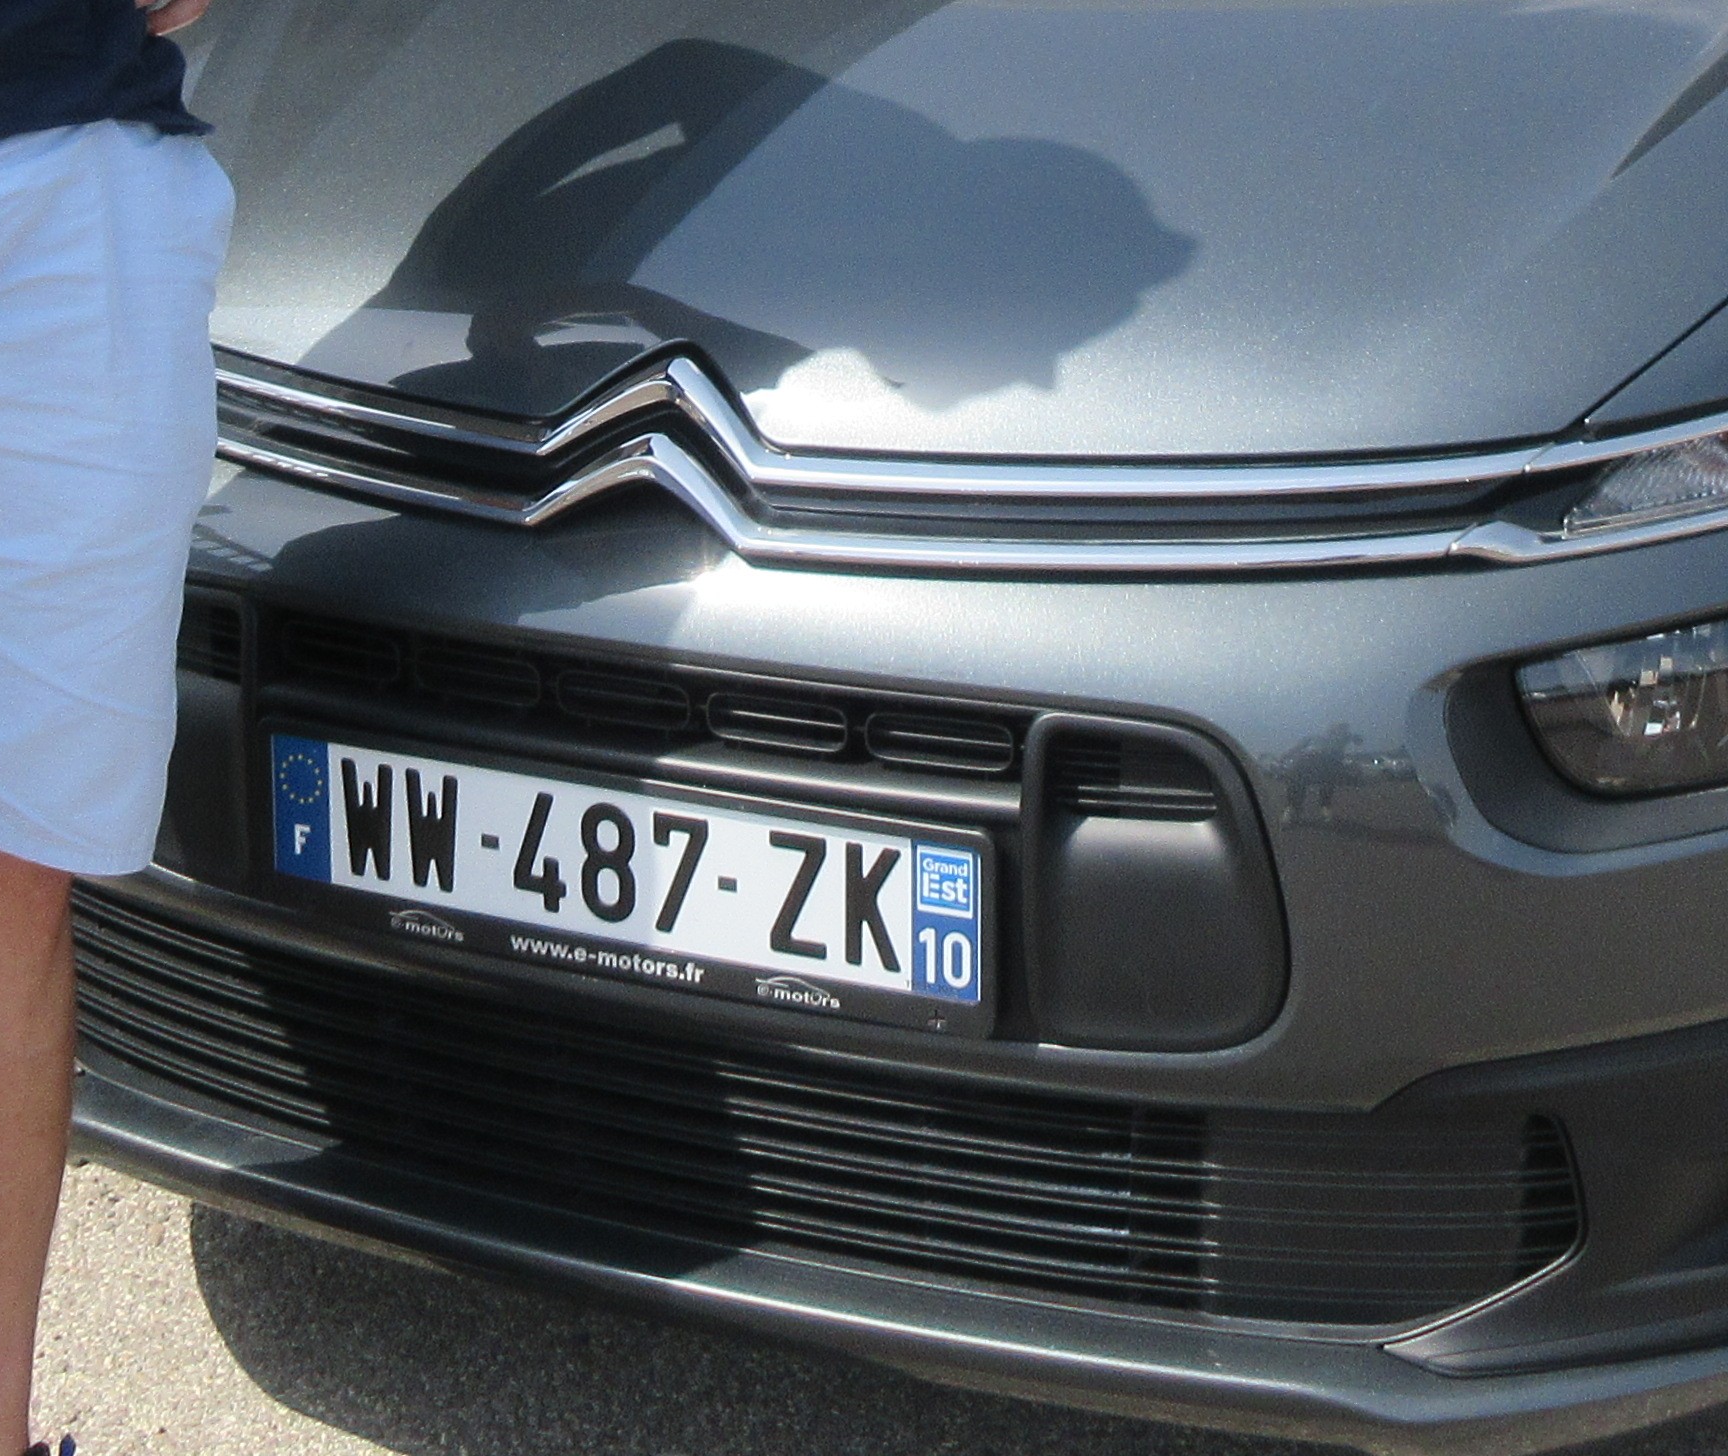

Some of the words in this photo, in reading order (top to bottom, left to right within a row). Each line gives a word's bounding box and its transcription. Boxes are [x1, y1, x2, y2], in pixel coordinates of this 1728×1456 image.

[294, 823, 311, 855] F
[922, 857, 969, 878] Grand
[922, 871, 968, 904] Est
[511, 934, 705, 983] www.e-motors.fr
[918, 927, 972, 989] 10
